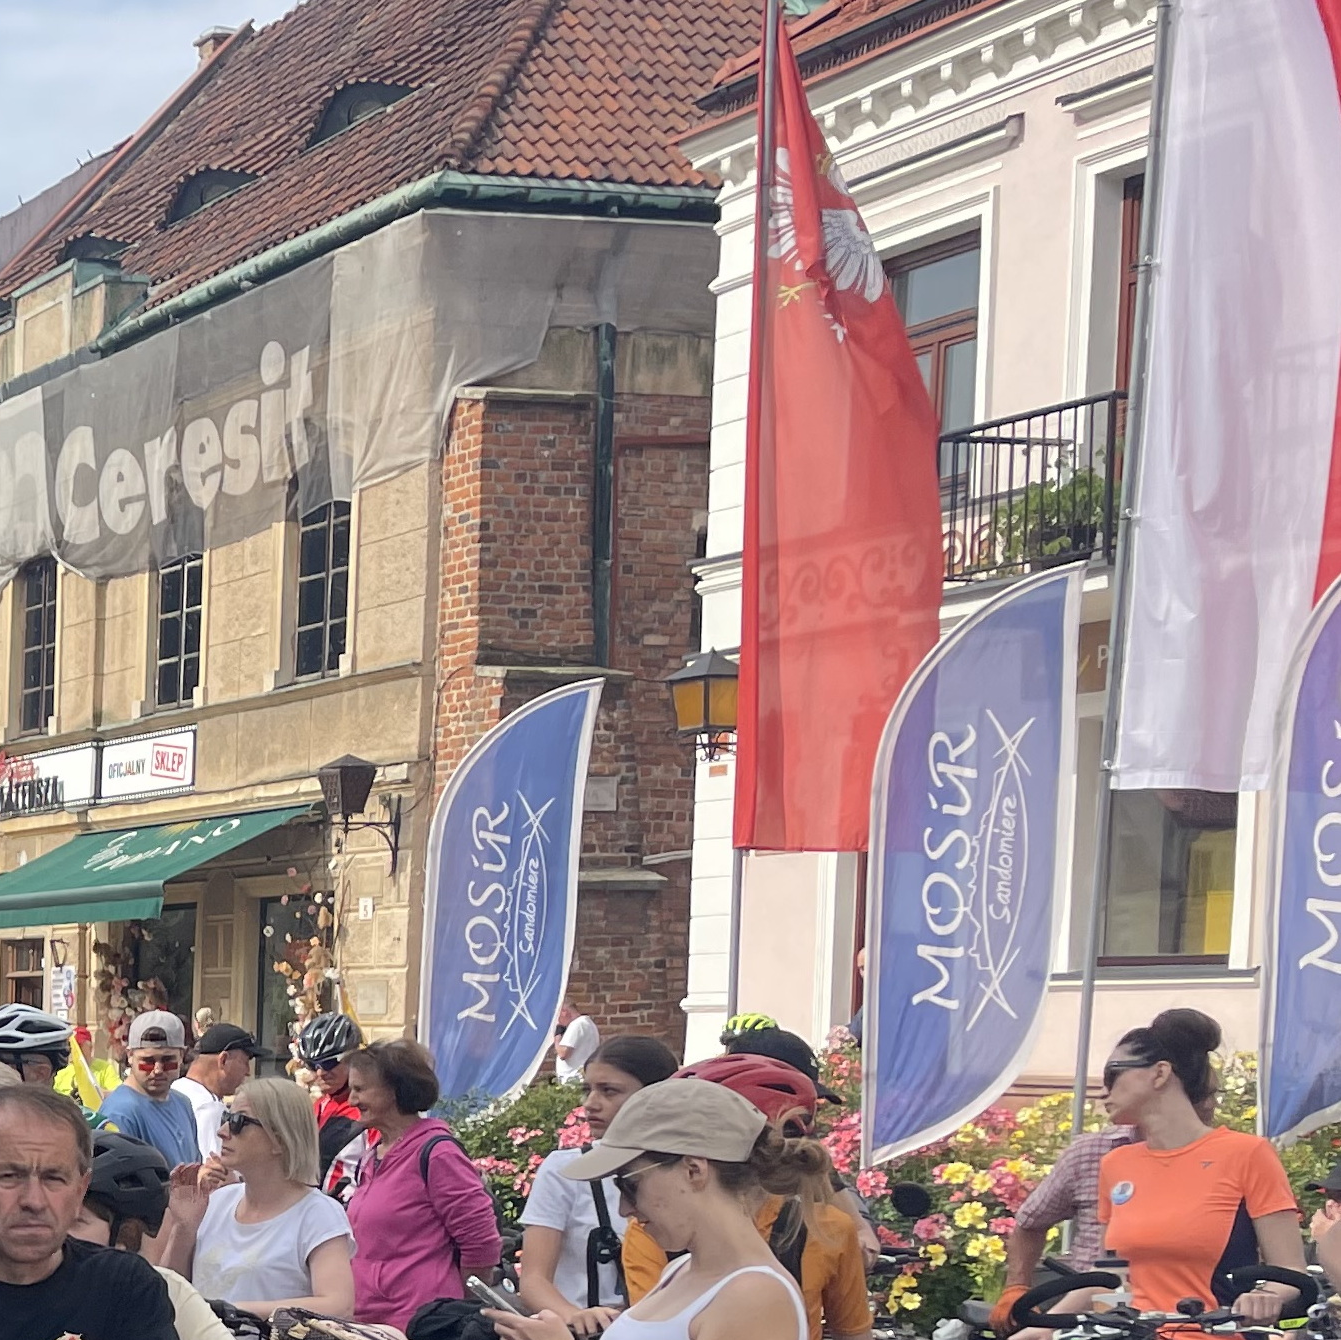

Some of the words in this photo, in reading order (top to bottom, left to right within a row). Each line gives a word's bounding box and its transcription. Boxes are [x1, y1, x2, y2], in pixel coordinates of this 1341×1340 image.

[55, 339, 315, 546] Ceresit
[108, 758, 147, 780] OFICJALNY
[153, 749, 185, 773] SKLEP
[518, 856, 541, 958] Sandomierz
[988, 793, 1018, 925] Sandomierz
